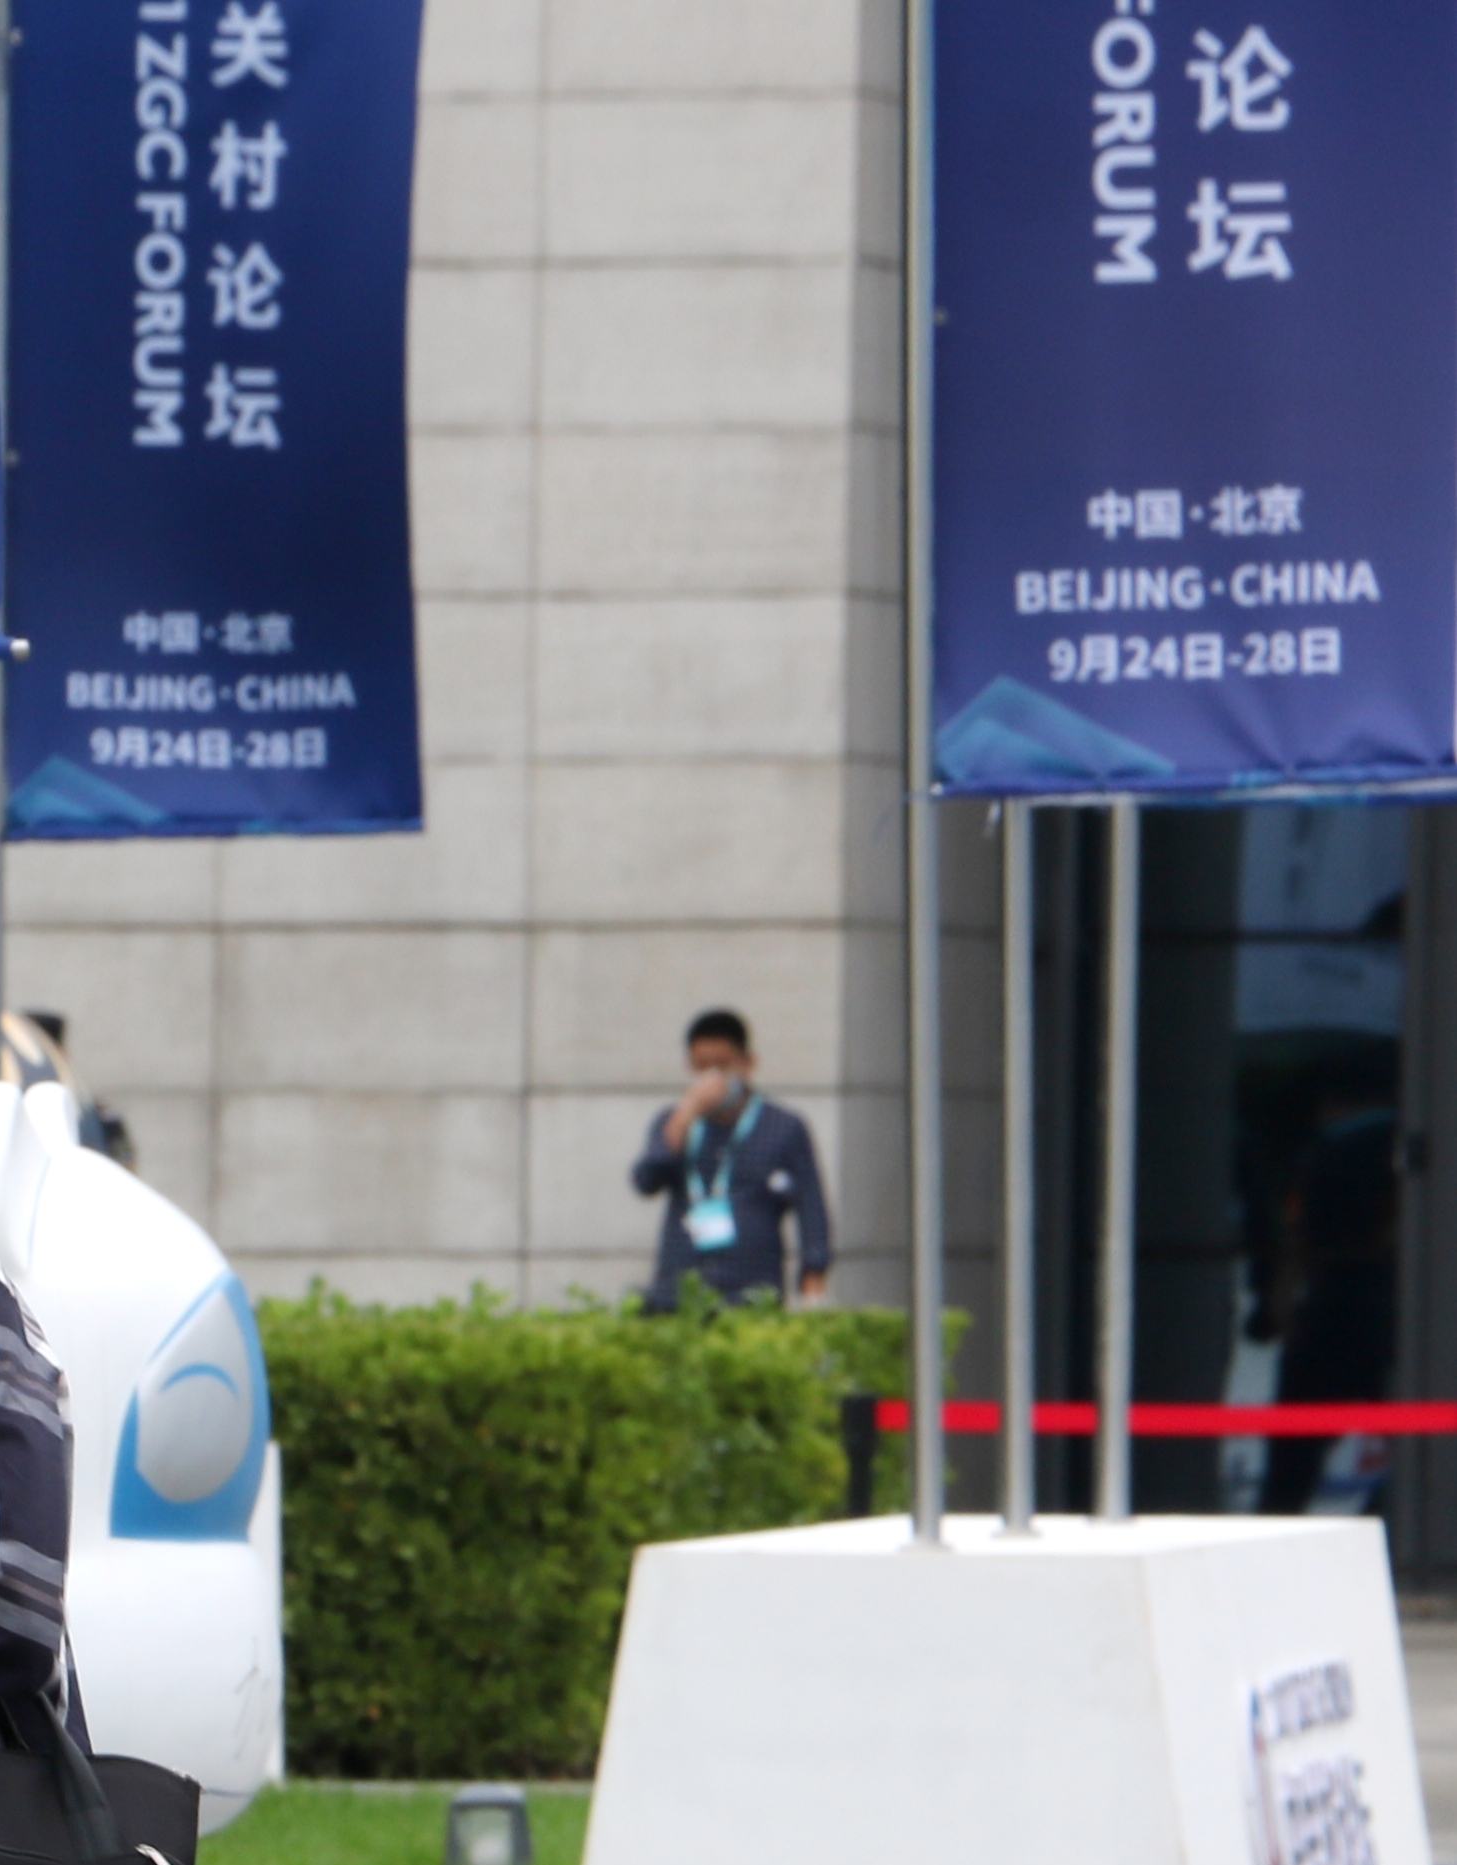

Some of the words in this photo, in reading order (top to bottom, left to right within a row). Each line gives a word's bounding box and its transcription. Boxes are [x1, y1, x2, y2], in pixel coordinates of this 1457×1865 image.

[134, 31, 188, 181] ZGC
[1185, 24, 1295, 283] 论坛
[205, 0, 290, 450] 关村论坛
[133, 191, 188, 448] FORUM
[1086, 484, 1304, 541] 中国·北京
[1014, 560, 1382, 615] BEIJING·CHINA
[122, 611, 293, 656] 中国·北京
[1048, 627, 1343, 685] 9月24日-28日
[66, 672, 357, 713] BEIJING·CHINA
[89, 725, 328, 772] 9月24日-28日
